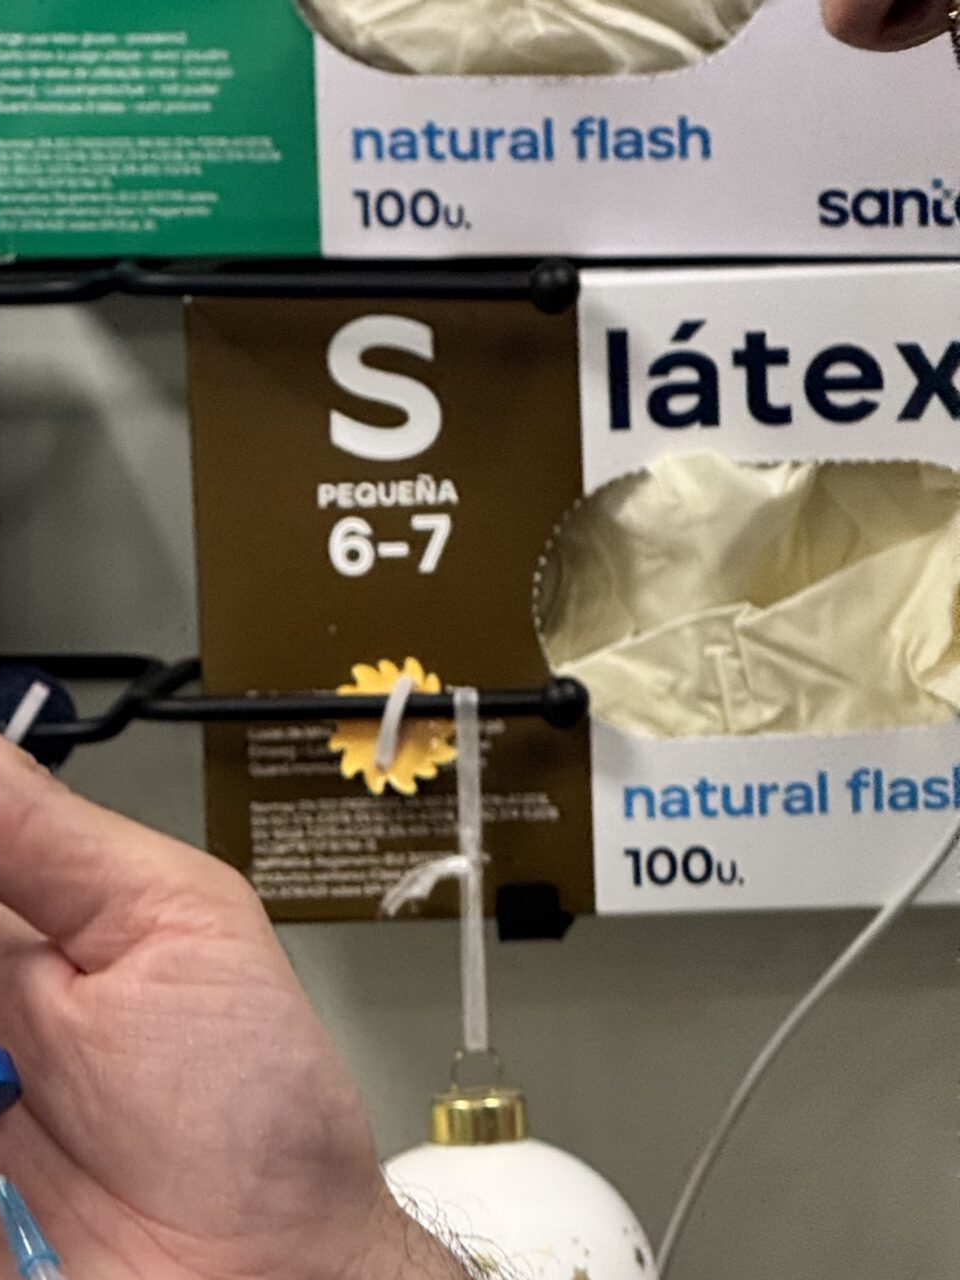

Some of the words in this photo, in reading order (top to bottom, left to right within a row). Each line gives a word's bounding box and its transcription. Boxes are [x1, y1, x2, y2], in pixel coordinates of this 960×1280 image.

[351, 116, 555, 162] natural
[571, 114, 713, 161] flash
[352, 188, 472, 230] 100u.
[326, 313, 442, 461] S
[606, 319, 960, 431] látex
[317, 473, 459, 508] PEQUEÑA
[328, 514, 453, 576] 6-7
[623, 769, 828, 820] natural
[845, 764, 960, 814] flas
[623, 845, 745, 888] 100u.
